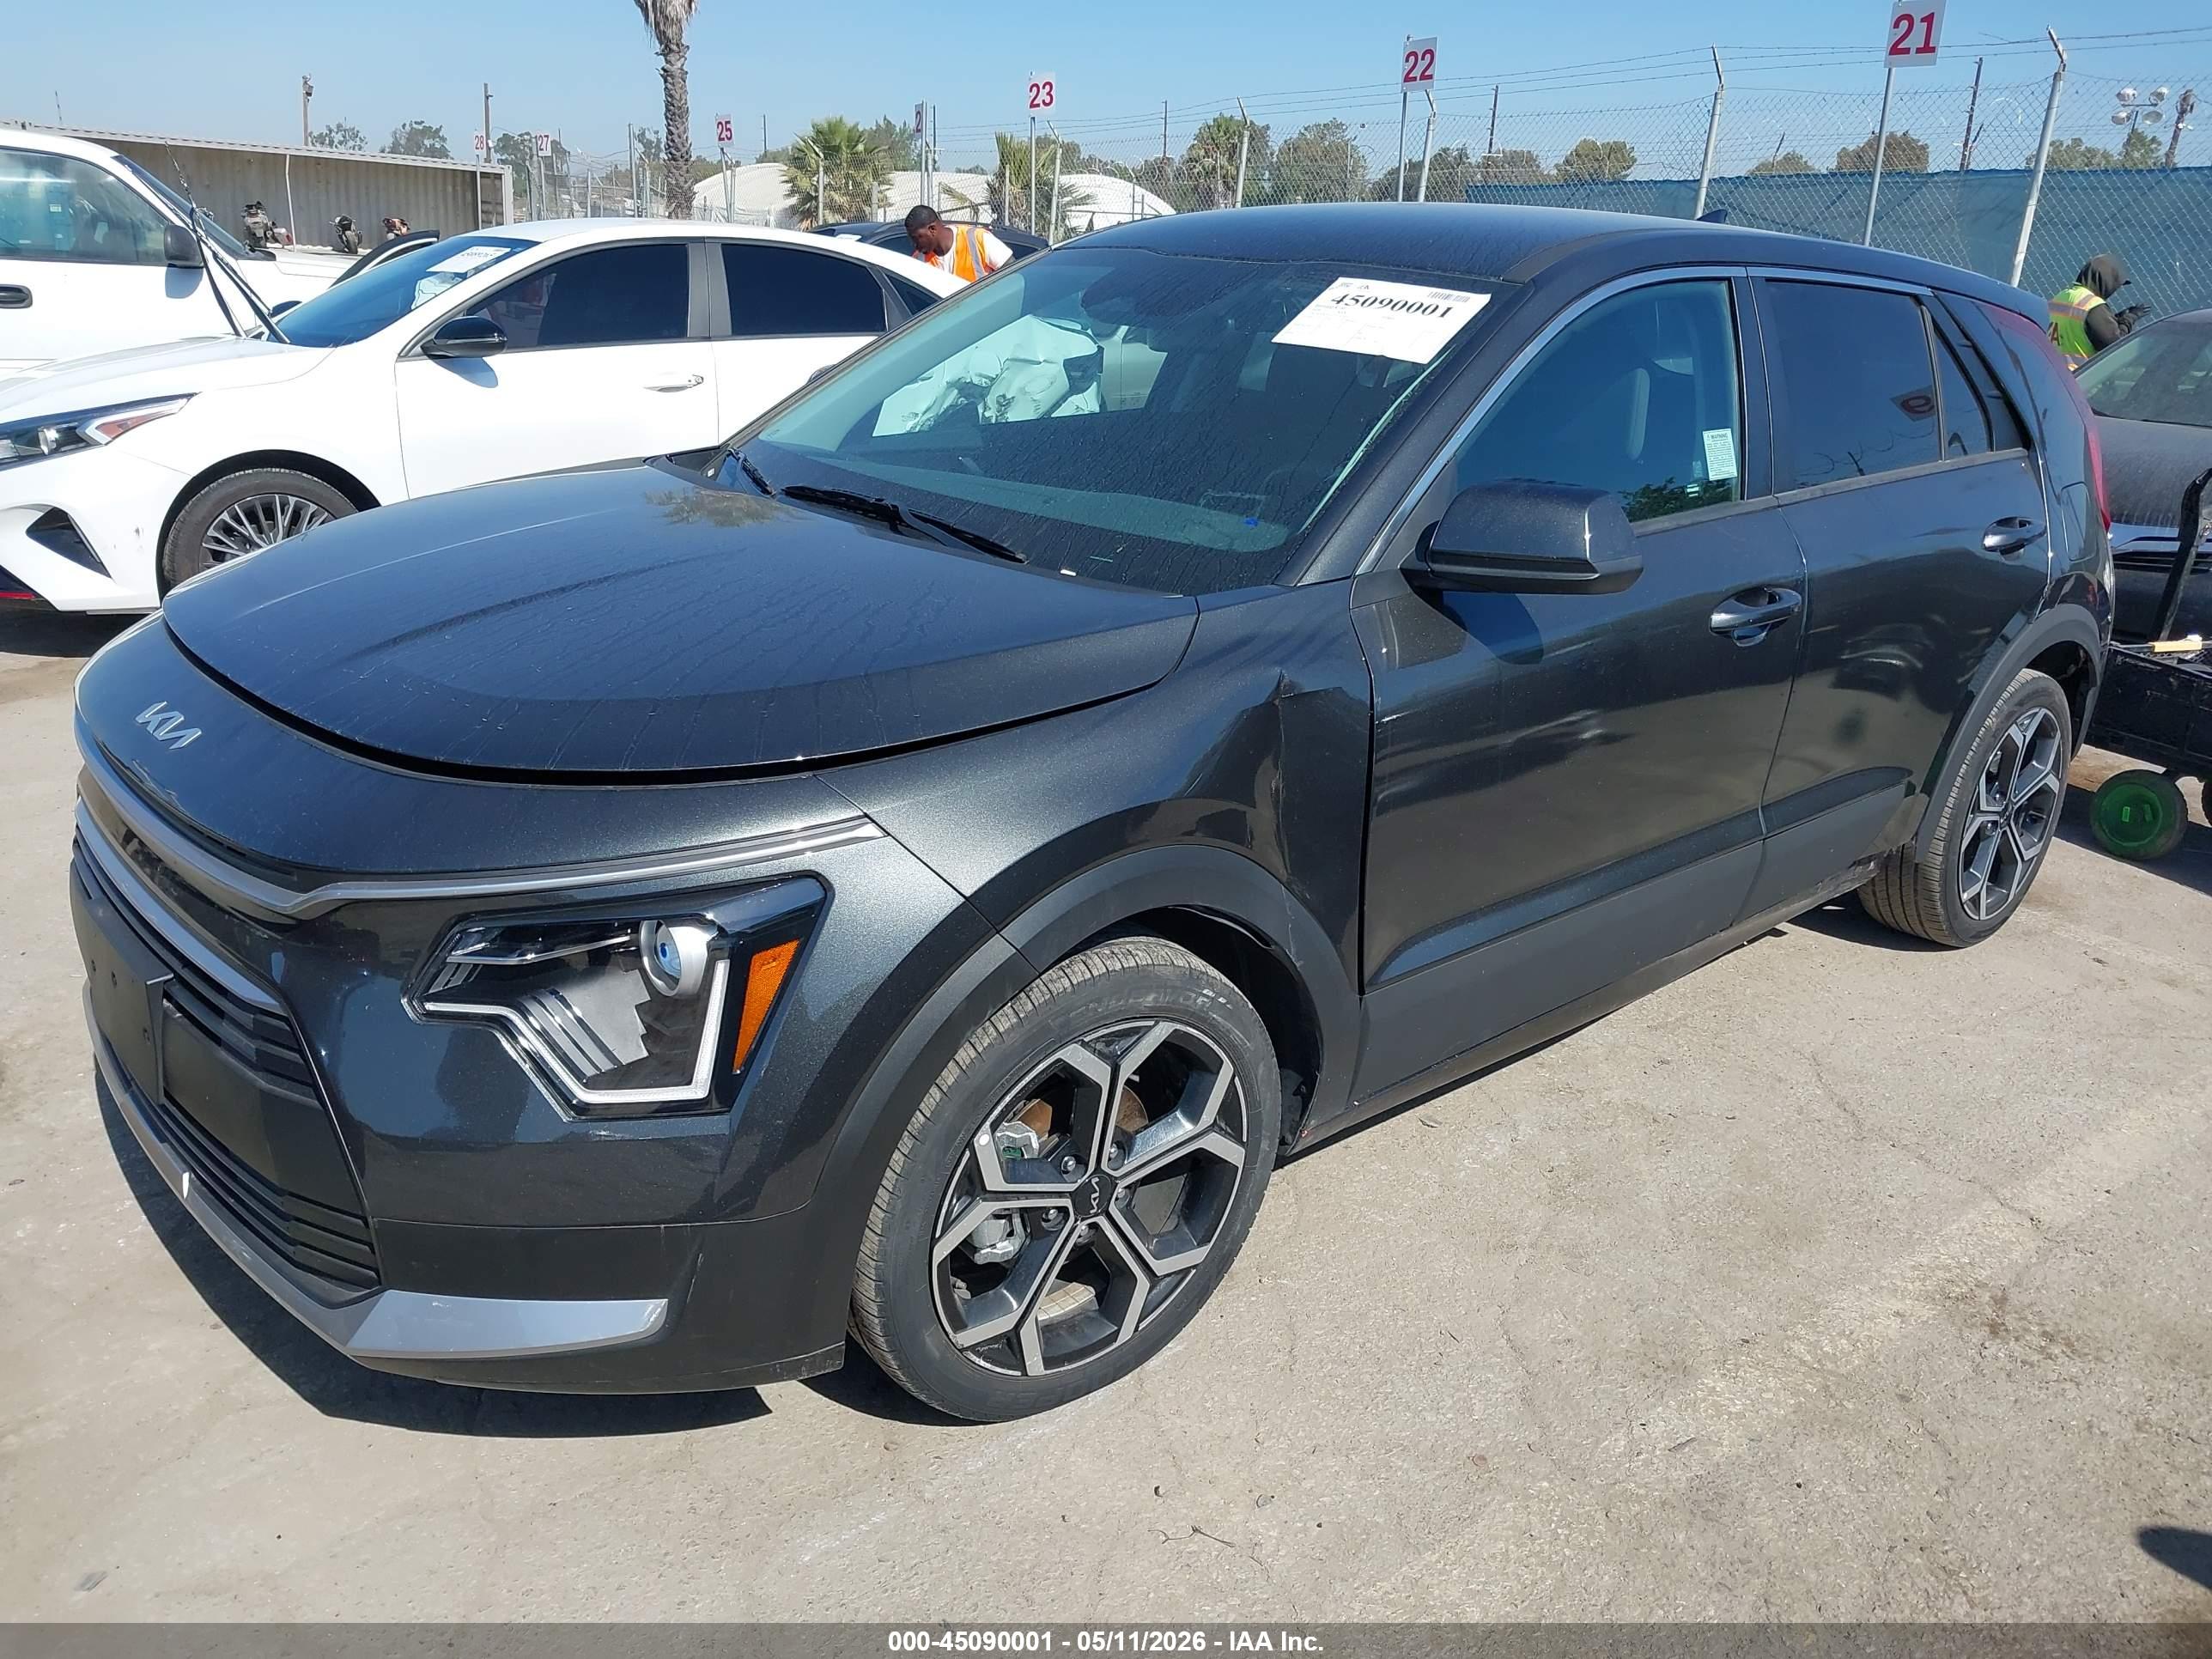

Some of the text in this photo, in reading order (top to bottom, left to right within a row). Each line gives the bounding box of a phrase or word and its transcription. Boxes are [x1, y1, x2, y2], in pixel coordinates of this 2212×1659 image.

[1888, 12, 1936, 56] 21
[1403, 48, 1435, 82] 22
[1030, 82, 1054, 109] 23
[717, 120, 732, 141] 25
[915, 110, 922, 133] 2
[474, 134, 485, 150] 28
[538, 134, 550, 152] 27
[1331, 293, 1455, 319] 45090001
[135, 701, 202, 750] KIA
